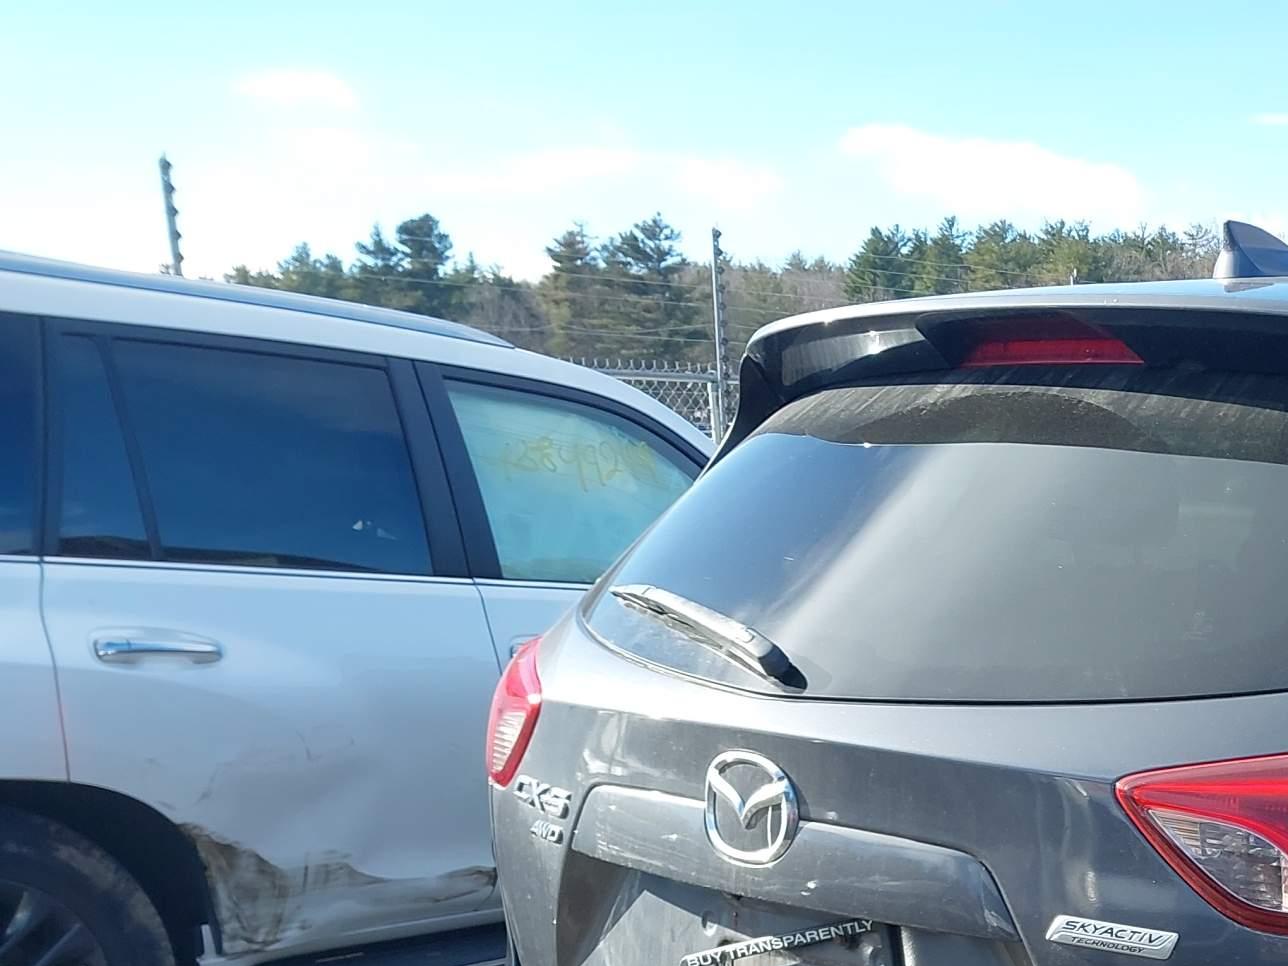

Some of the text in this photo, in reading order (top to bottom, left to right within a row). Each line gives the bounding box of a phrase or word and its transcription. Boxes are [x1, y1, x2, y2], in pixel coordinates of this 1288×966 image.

[727, 919, 873, 960] TRANSPARENTLY
[1061, 920, 1164, 944] SKYACTIV
[1070, 936, 1146, 954] TECHNOLOGY
